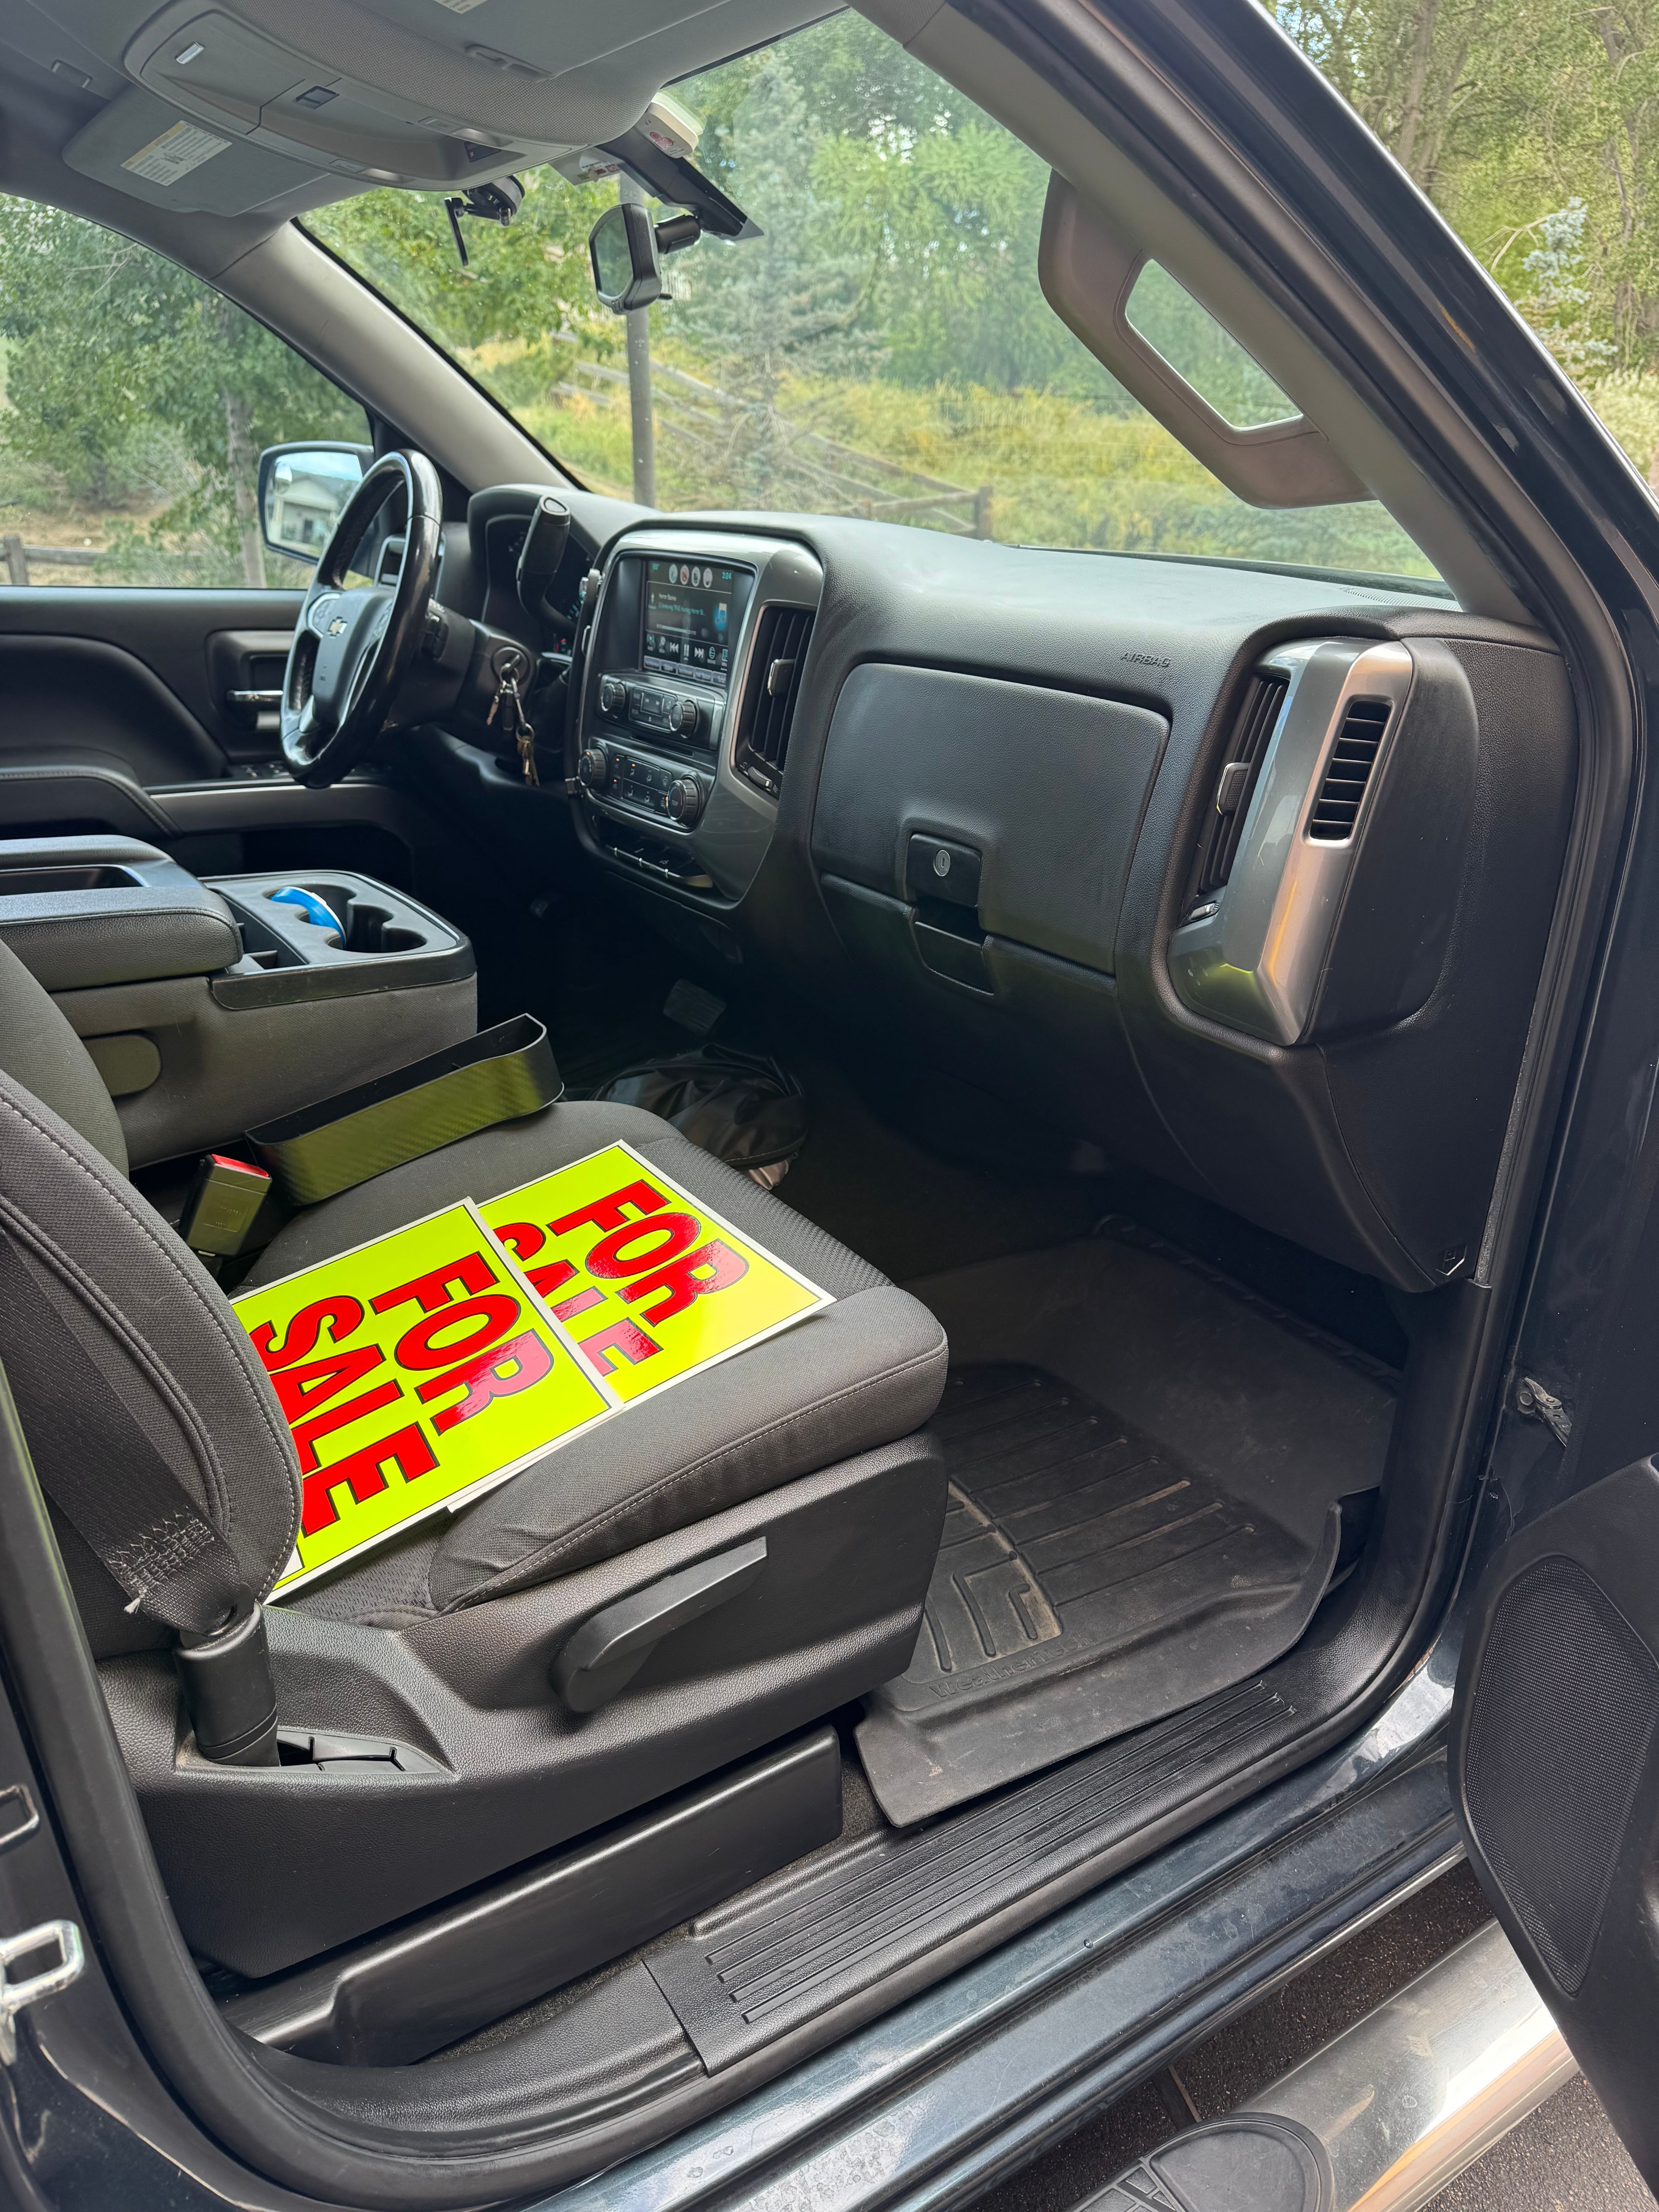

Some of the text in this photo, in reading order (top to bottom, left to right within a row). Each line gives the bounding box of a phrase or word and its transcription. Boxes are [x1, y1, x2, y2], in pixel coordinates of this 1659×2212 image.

[1120, 652, 1172, 667] AIRBAG
[545, 1179, 749, 1328] FOR
[249, 1295, 441, 1539] SALE
[368, 1250, 554, 1436] FOR
[928, 1630, 1095, 1698] WeatherTech
